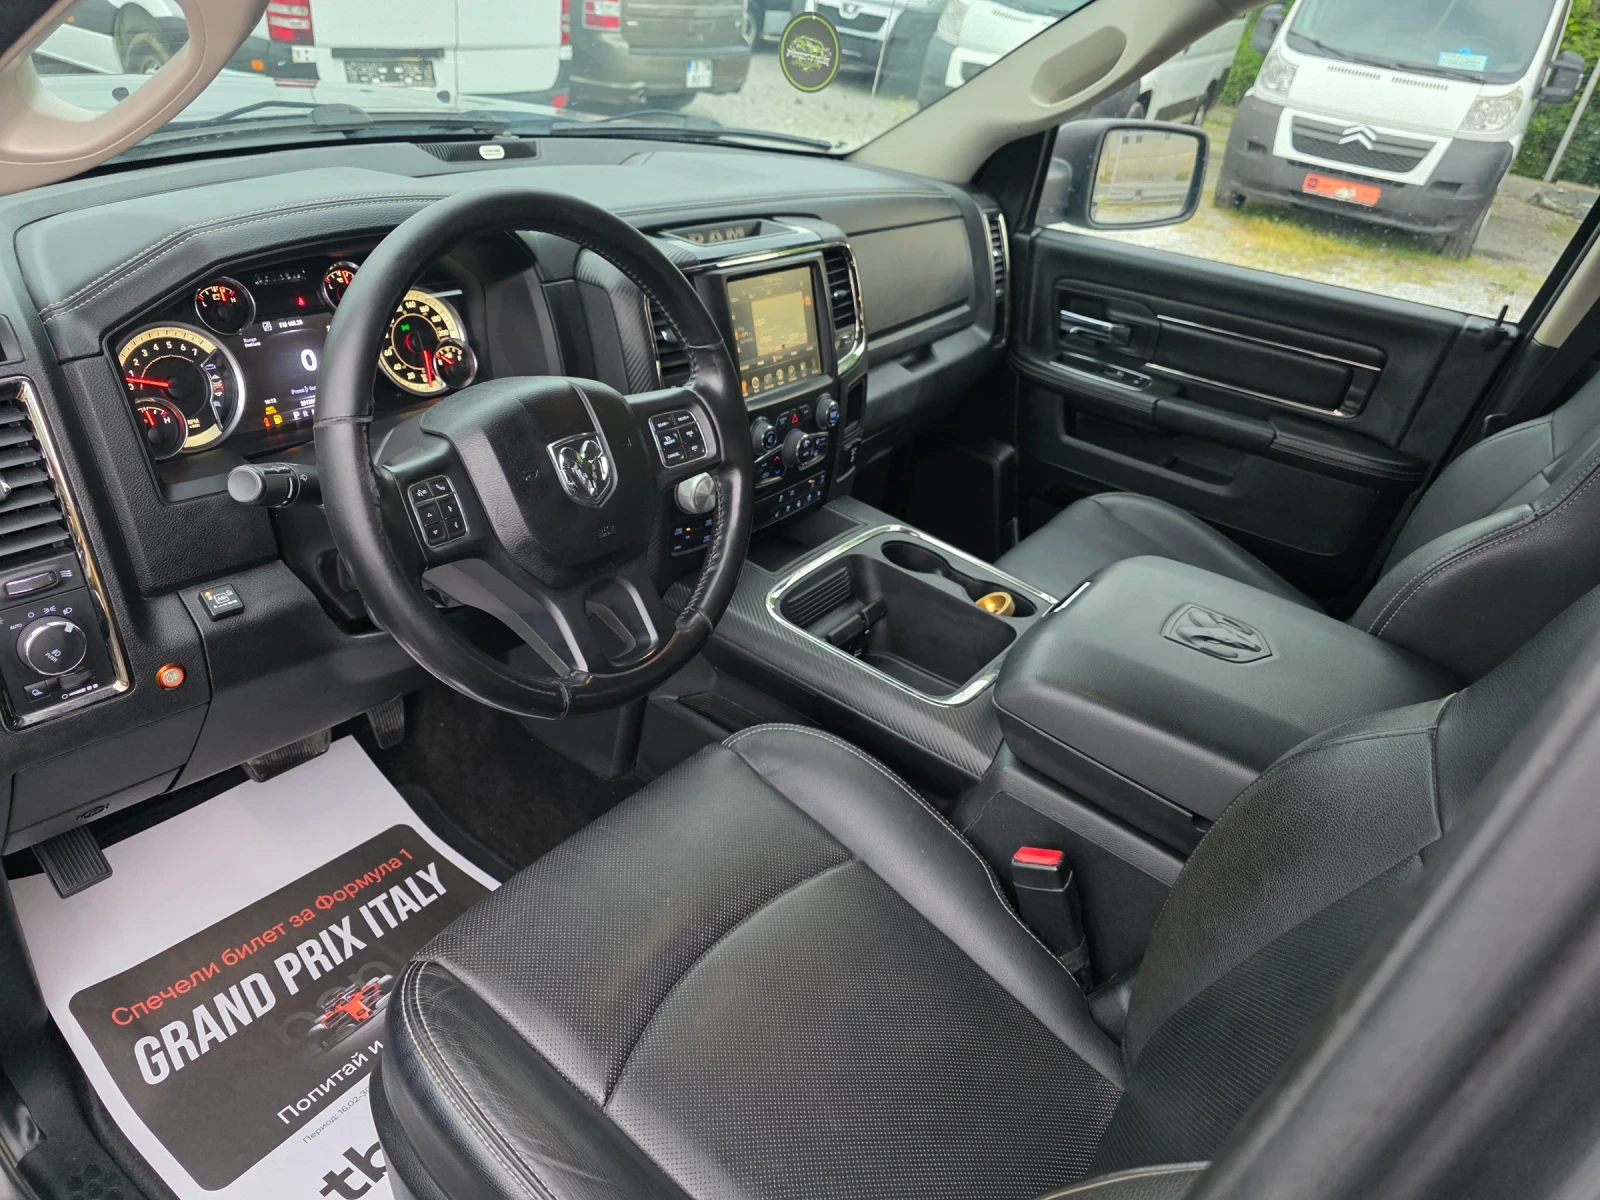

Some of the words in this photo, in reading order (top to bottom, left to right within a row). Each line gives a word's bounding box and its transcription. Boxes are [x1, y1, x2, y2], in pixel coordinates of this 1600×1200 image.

[688, 227, 745, 244] RAM
[153, 343, 159, 351] 4
[165, 341, 173, 349] 5
[180, 343, 187, 351] 6
[141, 349, 149, 357] 3
[191, 348, 198, 356] 7
[133, 358, 140, 366] 2
[300, 348, 318, 372] 0
[128, 369, 134, 377] 1
[293, 410, 300, 420] P
[45, 652, 59, 662] PUSH
[111, 961, 220, 1026] Спечели
[221, 923, 286, 965] билет
[289, 908, 316, 928] за
[315, 856, 403, 909] Формула
[398, 848, 413, 860] 1
[134, 972, 276, 1085] GRAND
[273, 915, 367, 996] PRIX
[359, 862, 447, 939] ITALY
[277, 1052, 368, 1124] Попитай
[368, 1040, 384, 1055] и
[302, 1114, 338, 1144] Период:
